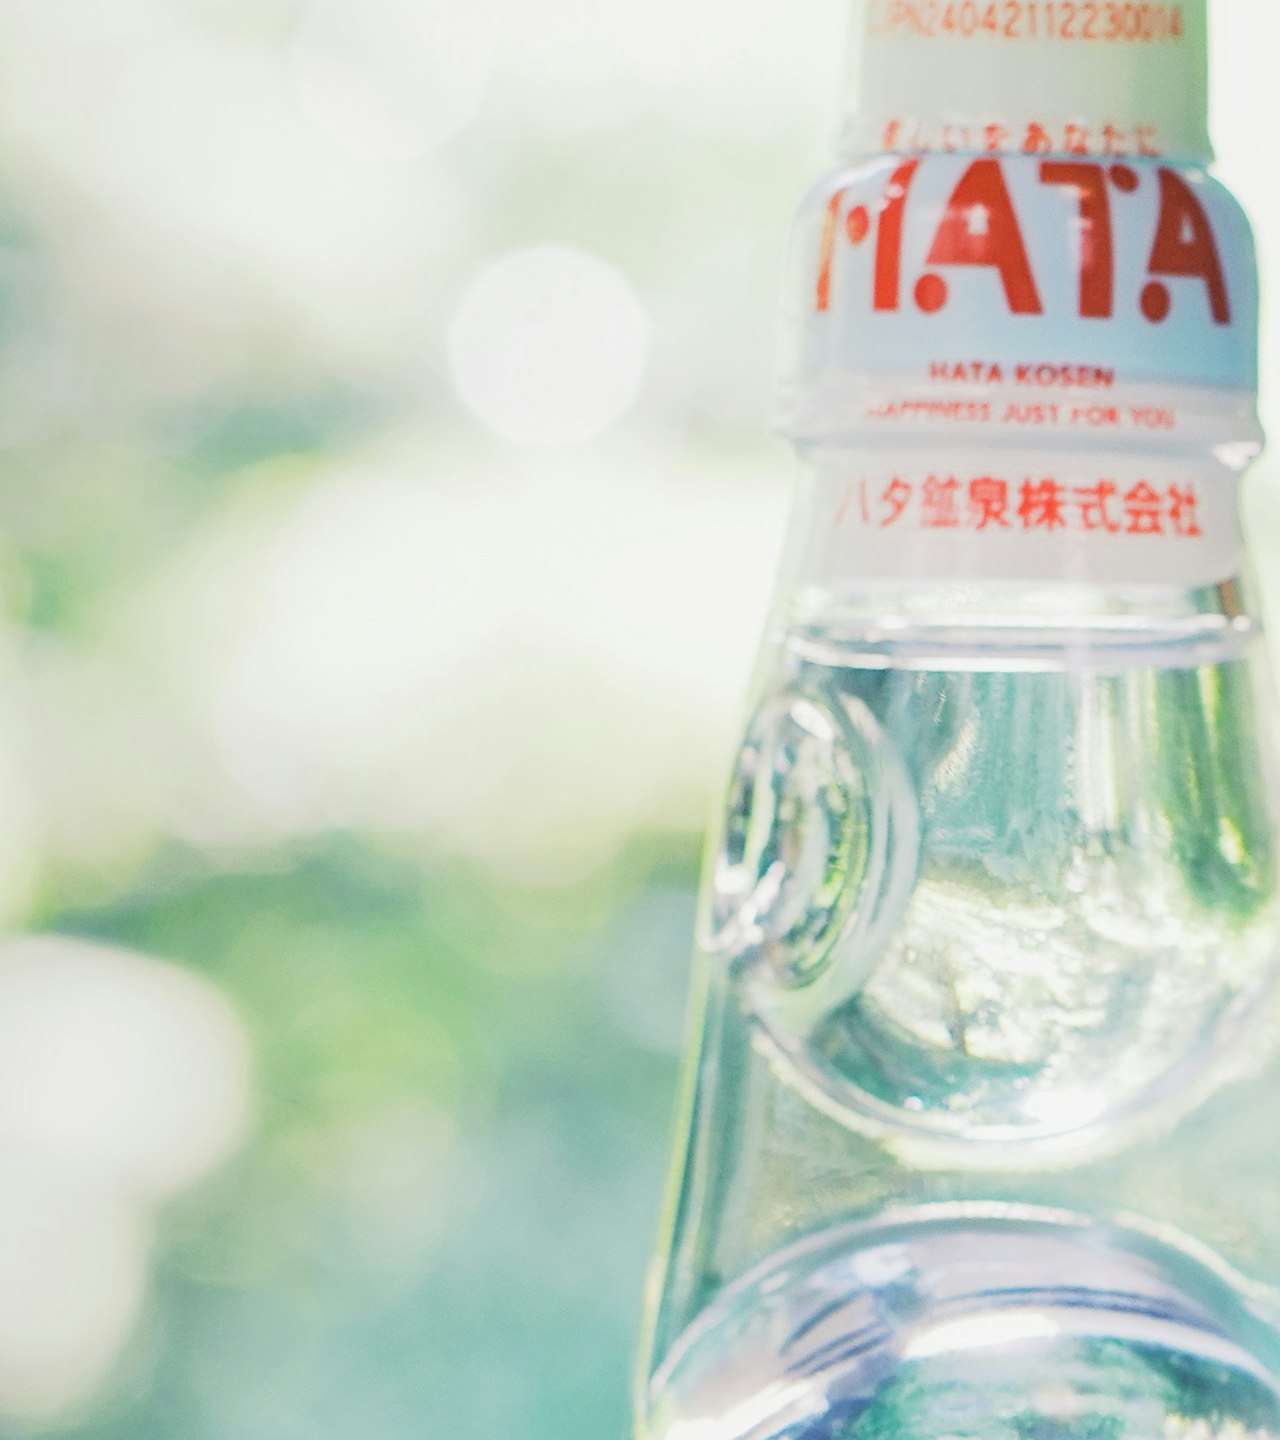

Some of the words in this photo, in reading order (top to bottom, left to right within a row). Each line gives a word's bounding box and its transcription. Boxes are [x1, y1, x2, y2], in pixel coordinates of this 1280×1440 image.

[815, 158, 1234, 326] HATA
[929, 361, 1003, 383] HATA
[1014, 362, 1115, 388] KOSEN
